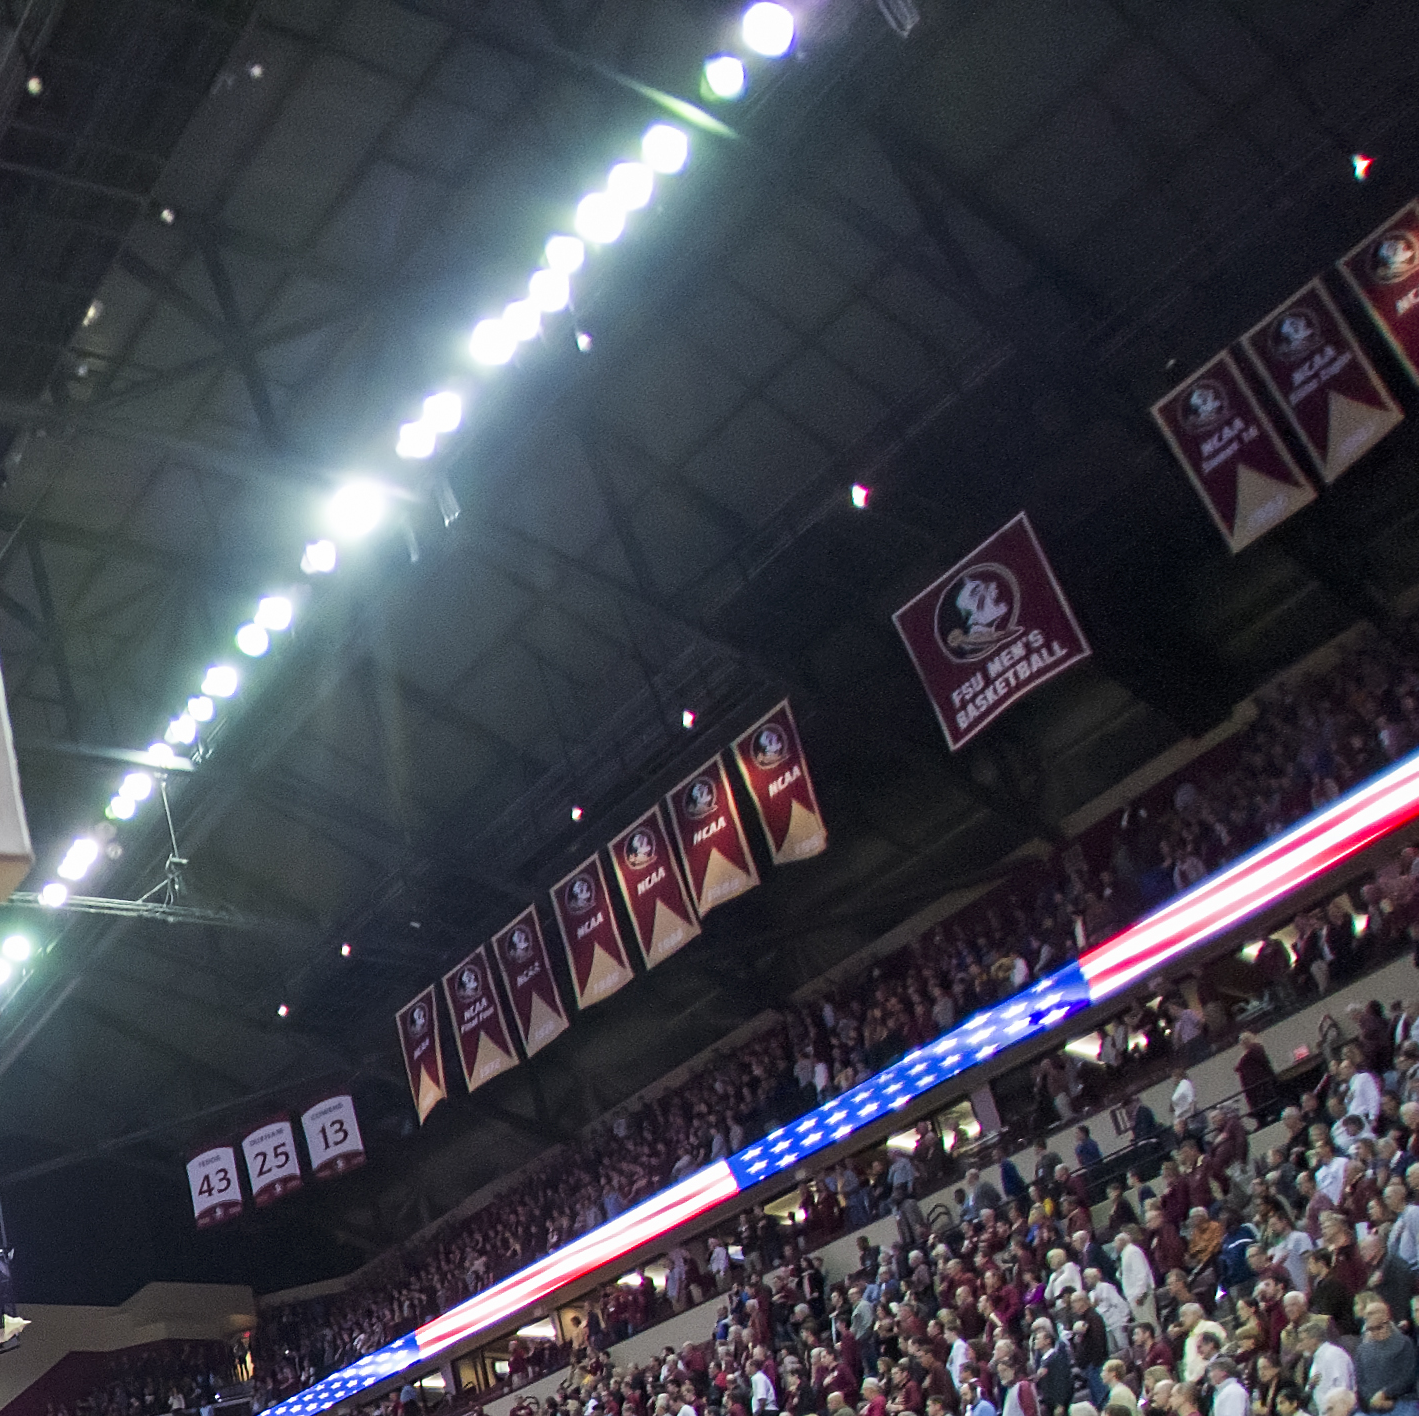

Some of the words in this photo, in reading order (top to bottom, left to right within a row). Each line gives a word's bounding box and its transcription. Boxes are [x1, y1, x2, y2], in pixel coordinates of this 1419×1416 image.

[951, 671, 985, 709] FSU
[986, 629, 1045, 679] MEN'S
[955, 641, 1069, 731] BASKETBALL
[768, 765, 802, 797] NCAA
[693, 816, 727, 846] NCAA
[637, 867, 666, 896] NCAA
[576, 911, 605, 940] NCAA
[463, 997, 488, 1021] NCAA
[317, 1119, 349, 1150] 13
[253, 1142, 291, 1178] 25
[197, 1167, 232, 1198] 43
